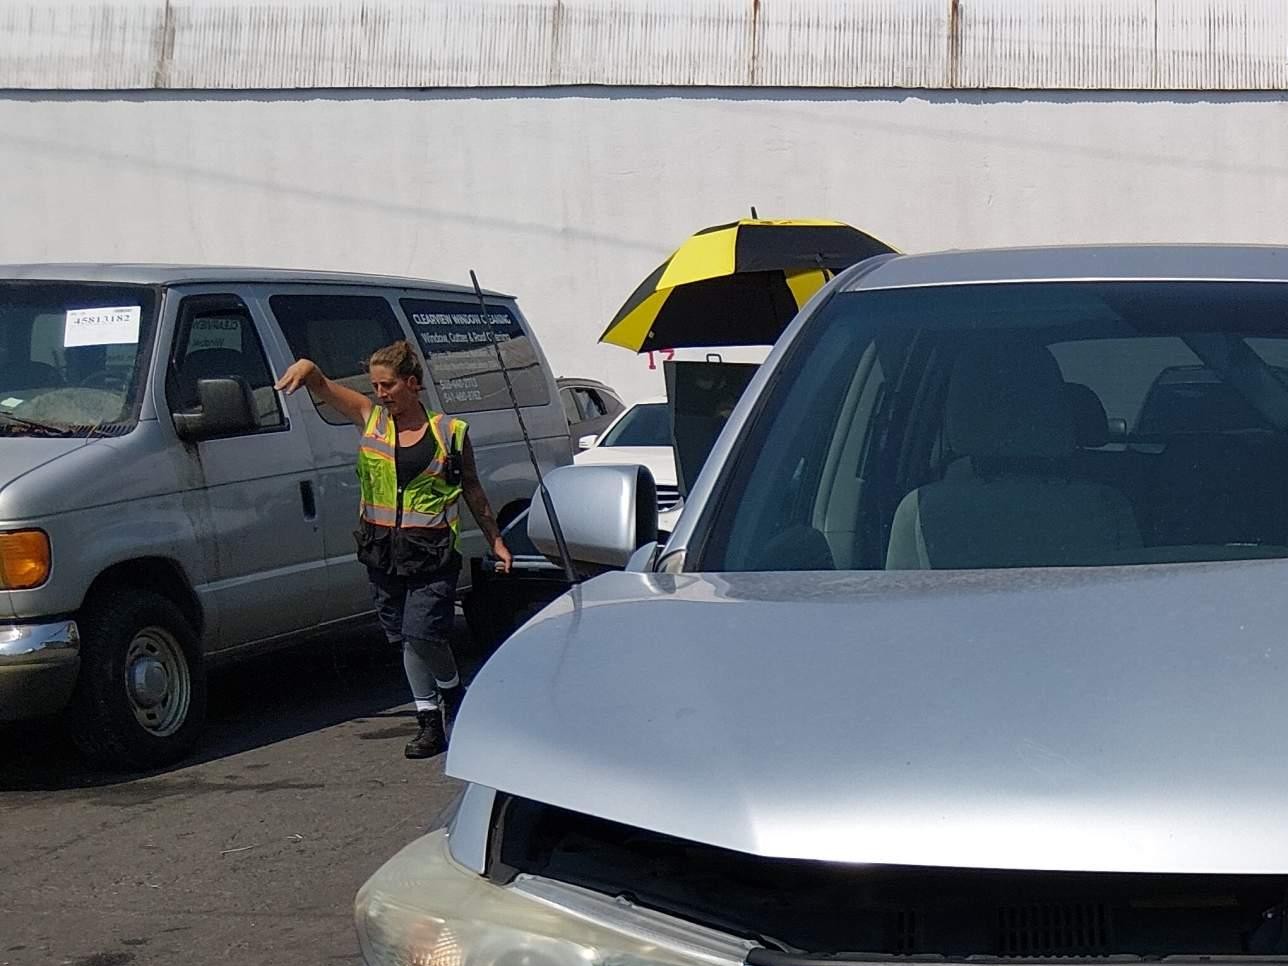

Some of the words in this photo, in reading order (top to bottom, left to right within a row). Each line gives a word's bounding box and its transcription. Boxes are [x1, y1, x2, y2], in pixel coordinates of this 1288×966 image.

[73, 314, 131, 326] 45813182
[412, 313, 453, 325] CLEARVIEW
[452, 314, 482, 325] WINDOW
[480, 313, 512, 325] CEANING
[485, 331, 512, 342] Ceaning
